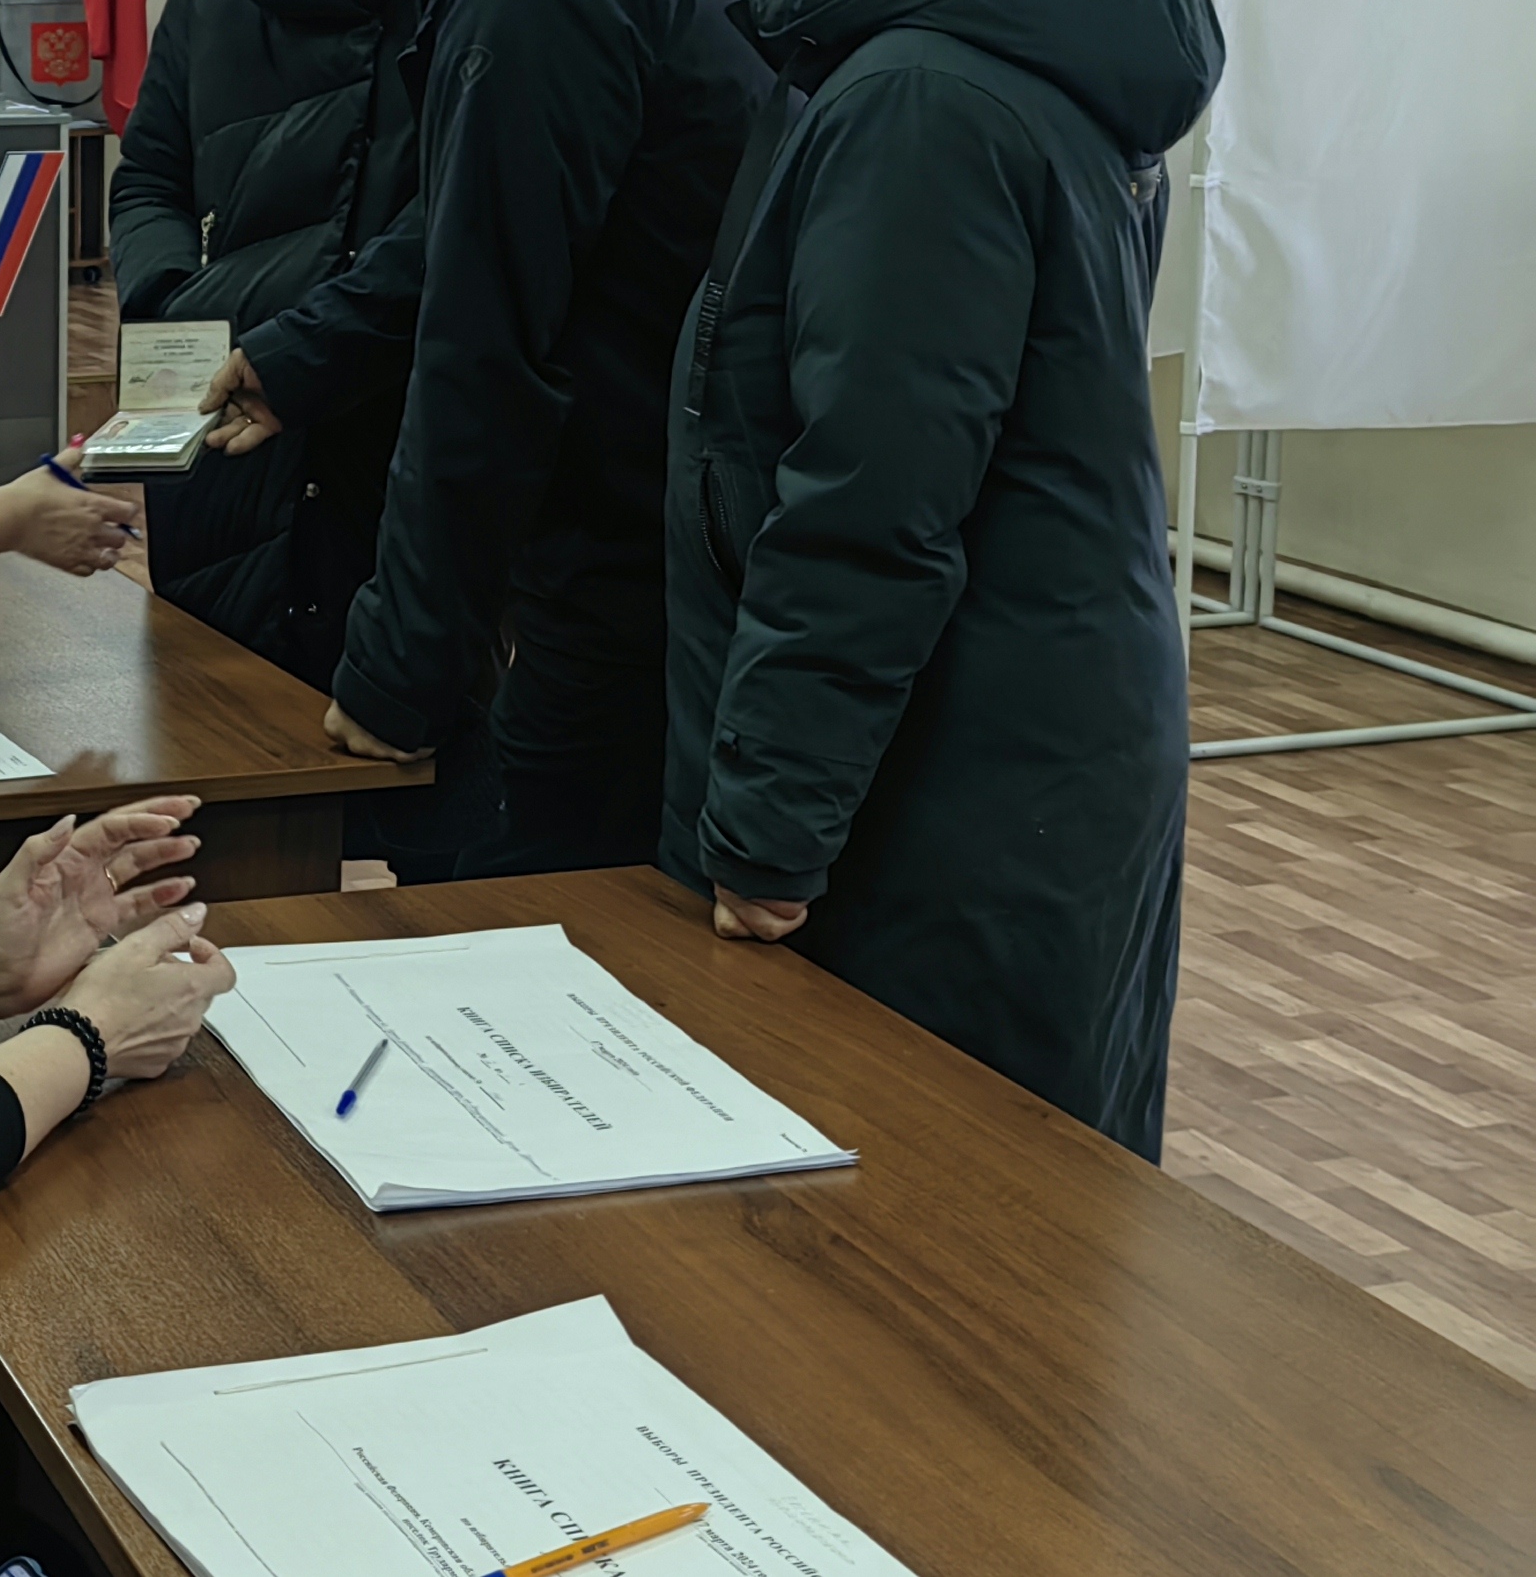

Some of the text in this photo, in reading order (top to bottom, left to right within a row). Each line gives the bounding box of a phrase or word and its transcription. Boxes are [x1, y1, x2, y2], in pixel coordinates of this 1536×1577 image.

[457, 1006, 495, 1033] КНИГА
[489, 1033, 534, 1070] СПИСКА
[529, 1069, 613, 1131] ИЗБИРАТЕЛЕЙ
[492, 1459, 554, 1509] КНИГА
[635, 1425, 689, 1466] ВЫБОРЫ
[686, 1469, 763, 1535] ПРЕЗИДЕНТА
[705, 1529, 734, 1552] марта
